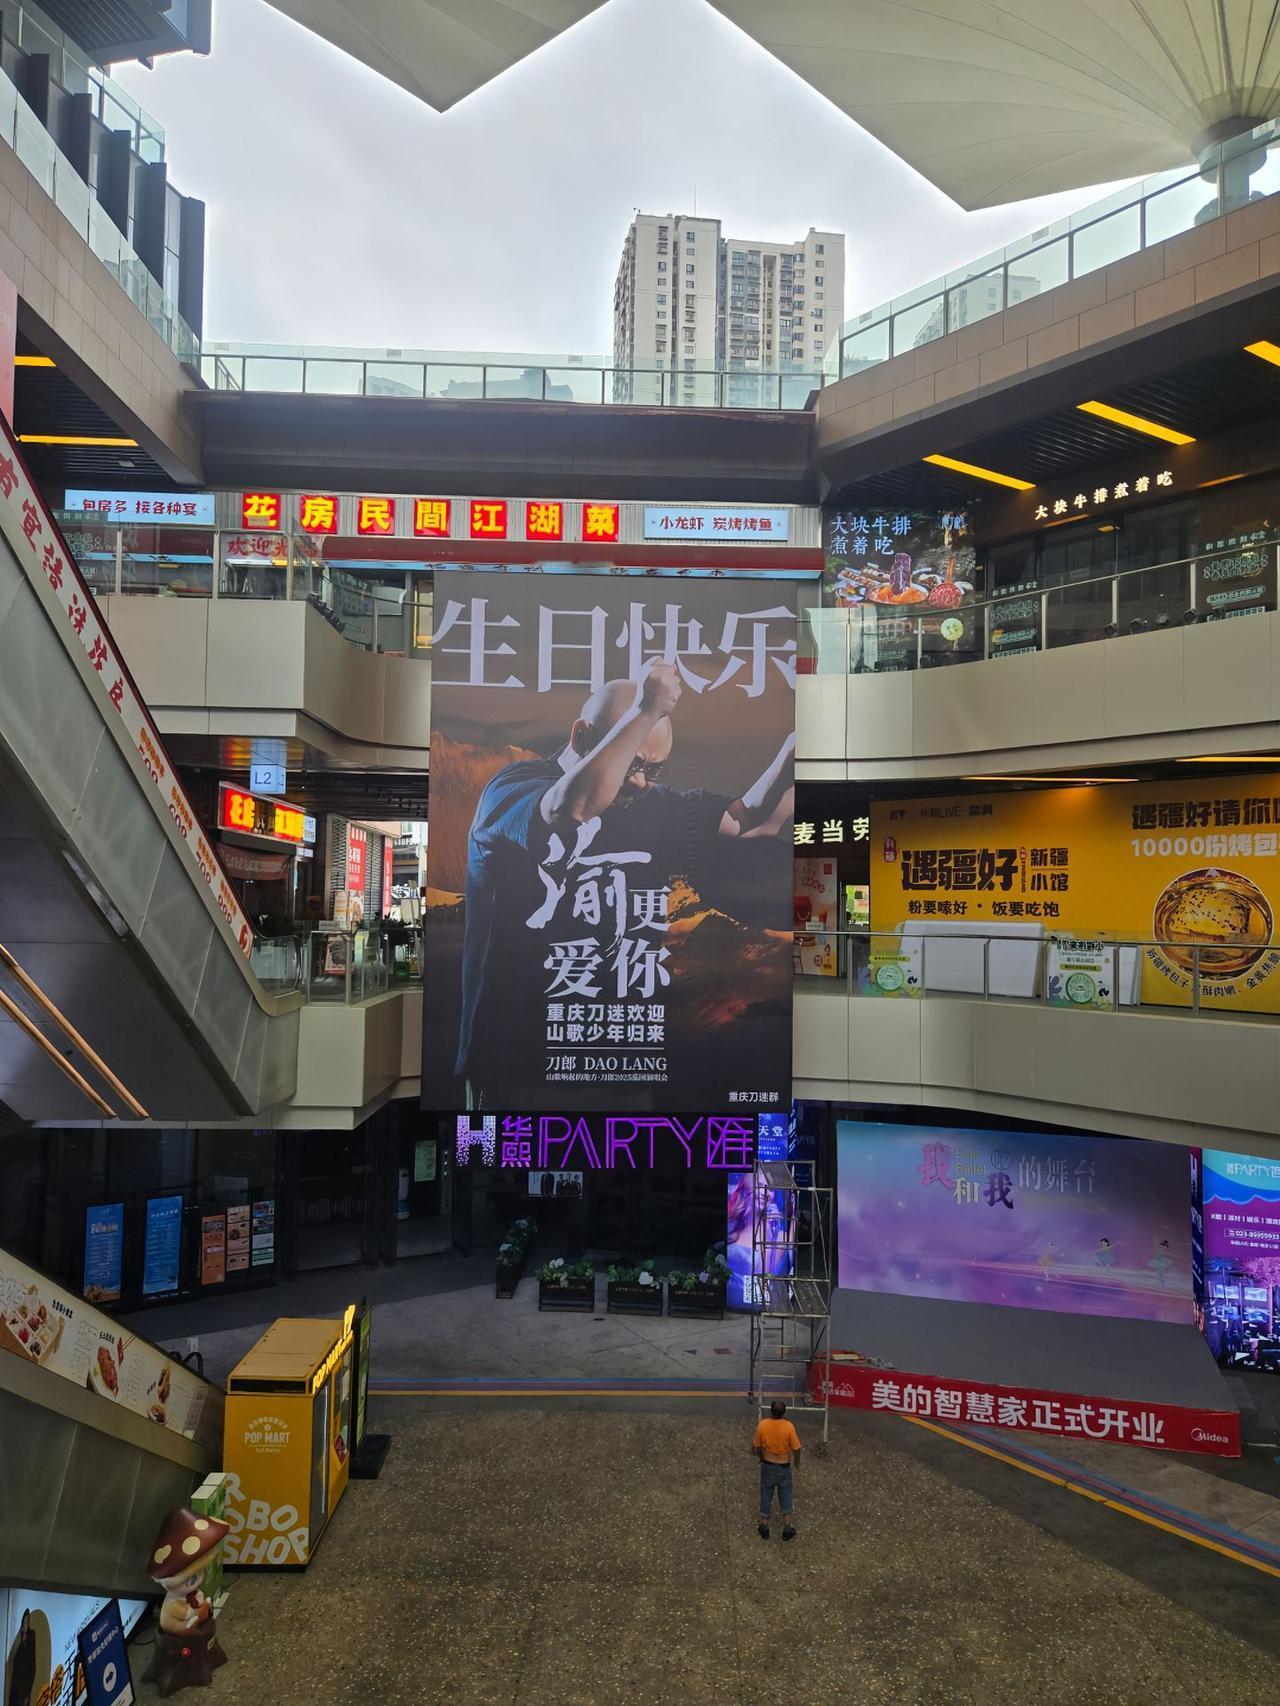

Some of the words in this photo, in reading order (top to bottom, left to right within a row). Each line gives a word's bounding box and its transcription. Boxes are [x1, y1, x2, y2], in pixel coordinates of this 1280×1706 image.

[1035, 470, 1173, 520] 大块牛排煮着吃
[82, 498, 128, 514] 包房多
[136, 500, 197, 516] 接各种宴
[659, 516, 704, 530] 小龙虾
[713, 517, 772, 532] 炭烤烤鱼
[831, 515, 912, 536] 大块牛排
[831, 536, 894, 555] 煮着吃
[431, 597, 797, 698] 生日快乐
[254, 771, 272, 785] L2
[1030, 847, 1069, 867] 新疆
[901, 848, 1018, 892] 遇疆好
[1030, 872, 1069, 892] 小馆
[908, 900, 968, 916] 粉要嗦好
[992, 901, 1060, 917] 饭要吃饱
[544, 937, 672, 999] 爱你
[547, 1003, 665, 1022] 重庆刀迷欢迎
[547, 1024, 665, 1043] 山歌少年归来
[546, 1055, 577, 1072] 刀郎
[584, 1057, 618, 1071] DAO
[622, 1057, 667, 1071] LANG
[728, 1091, 779, 1103] 重庆刀迷群
[501, 1115, 532, 1168] 华熙
[244, 1432, 263, 1444] POP
[264, 1432, 290, 1444] MART
[1195, 1430, 1229, 1444] Midea
[223, 1527, 310, 1565] SHOP
